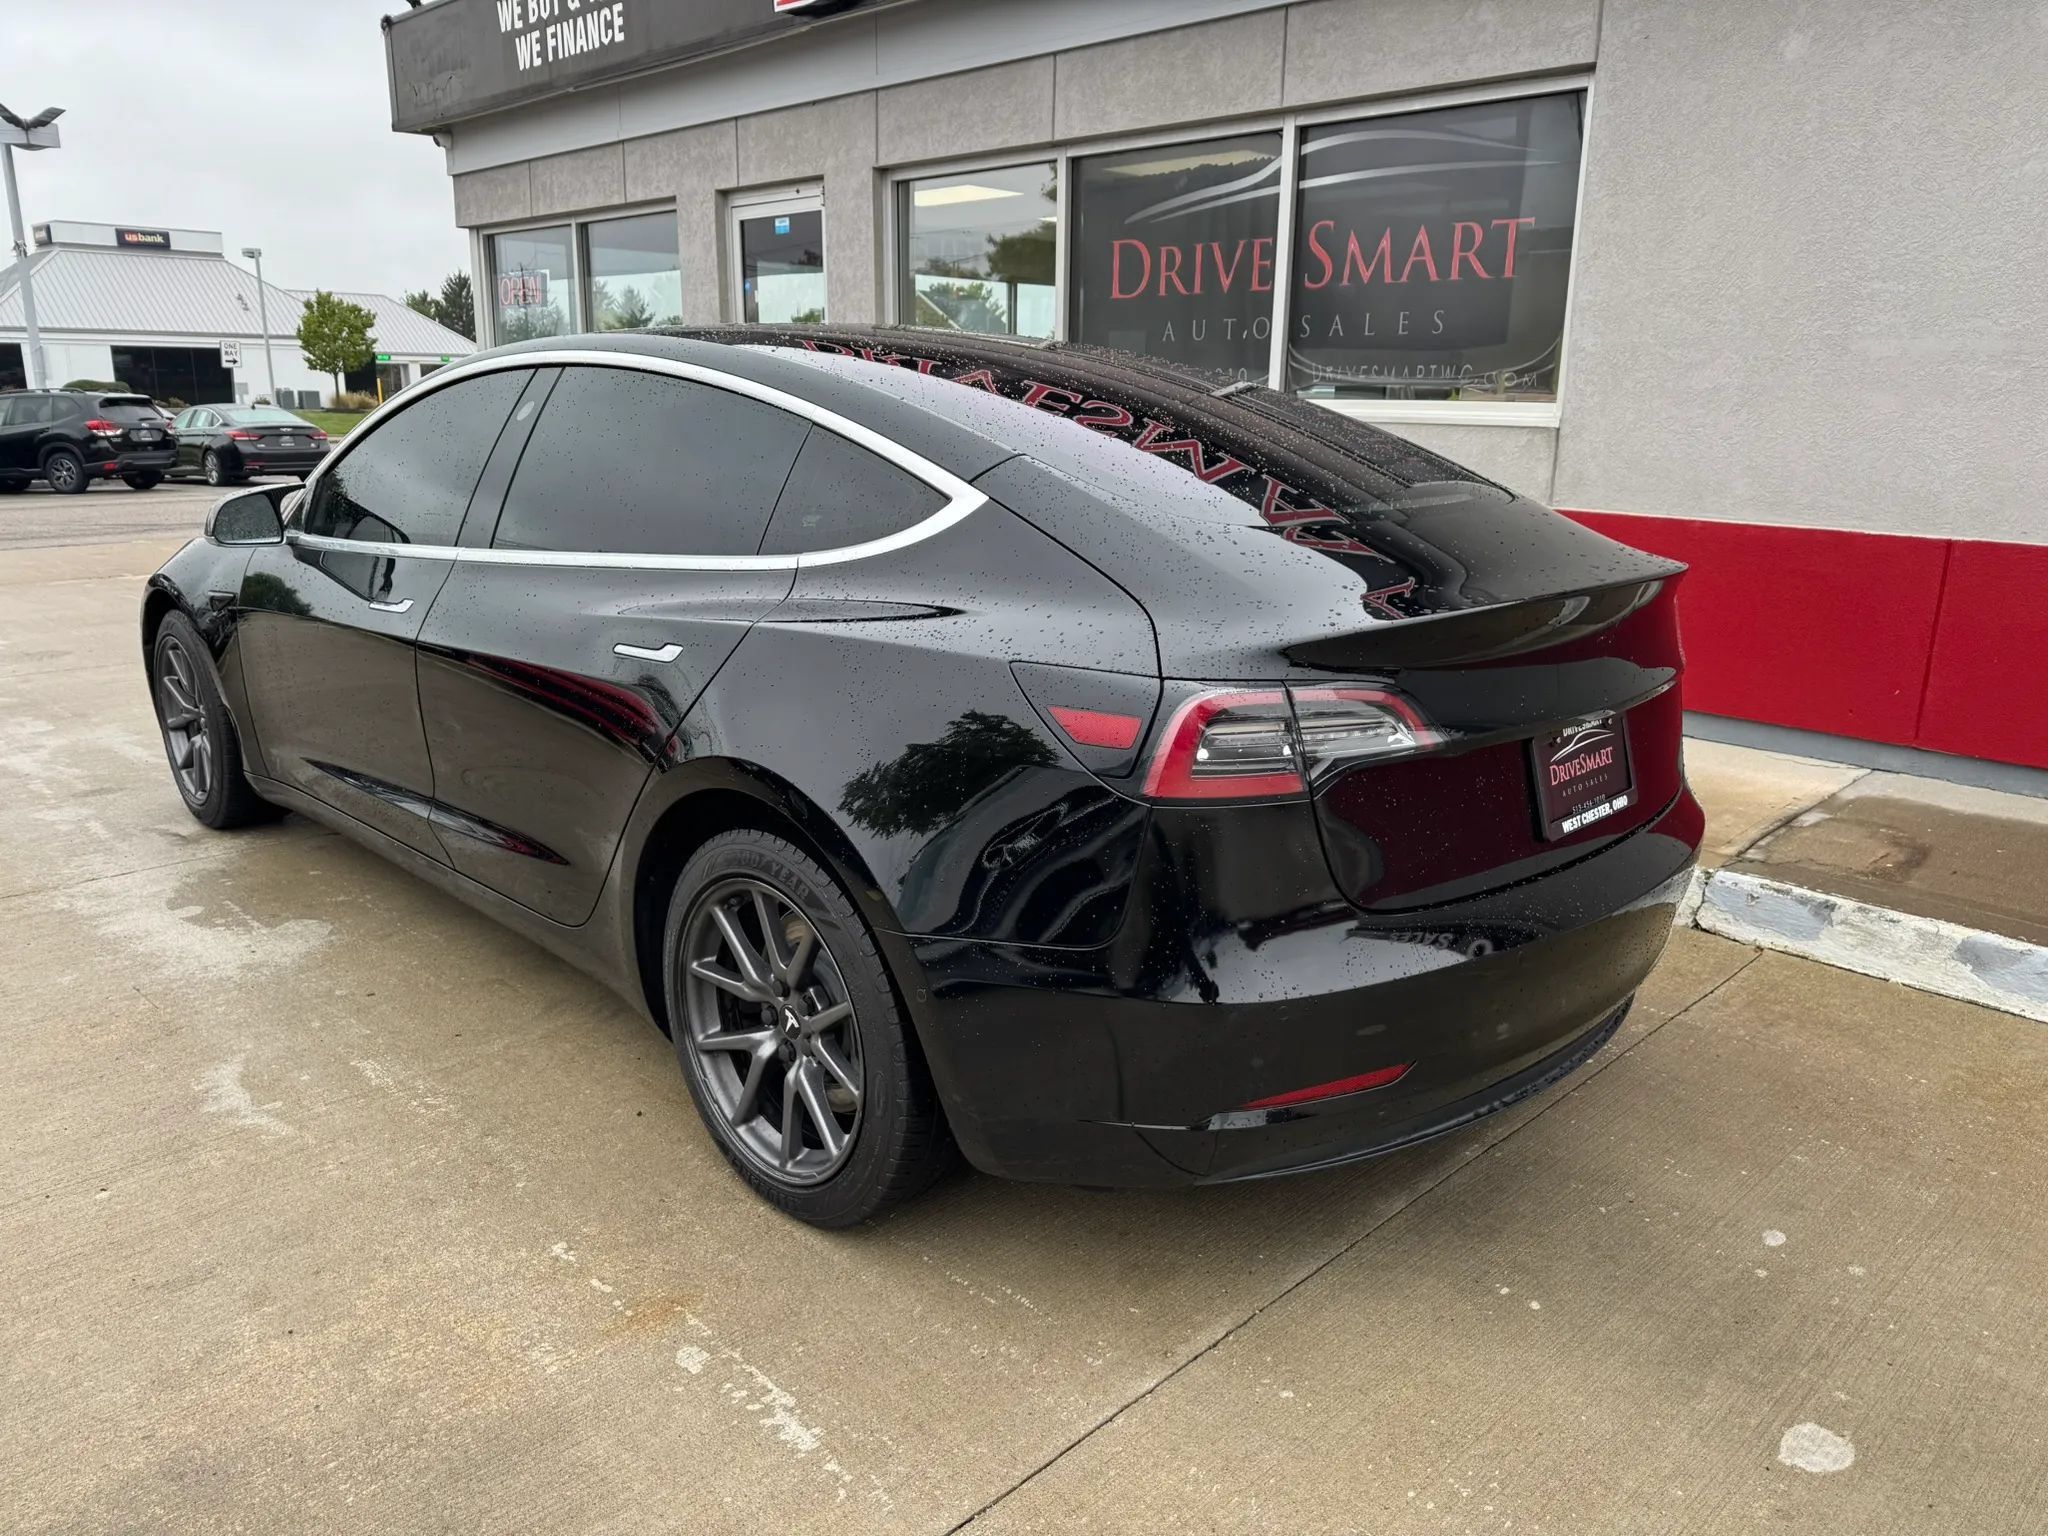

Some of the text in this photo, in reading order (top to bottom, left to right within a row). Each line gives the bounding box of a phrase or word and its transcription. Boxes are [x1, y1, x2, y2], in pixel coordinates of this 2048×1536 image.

[496, 0, 523, 33] WE
[515, 2, 625, 71] WE FINANCE
[500, 276, 542, 305] OPEN
[1162, 309, 1445, 342] AUTO SALES
[223, 342, 238, 350] ONE
[1549, 746, 1613, 786] DRIVESMART
[1562, 772, 1608, 797] AUTO SALES
[1561, 814, 1581, 834] WEST
[1612, 795, 1628, 811] OHIO
